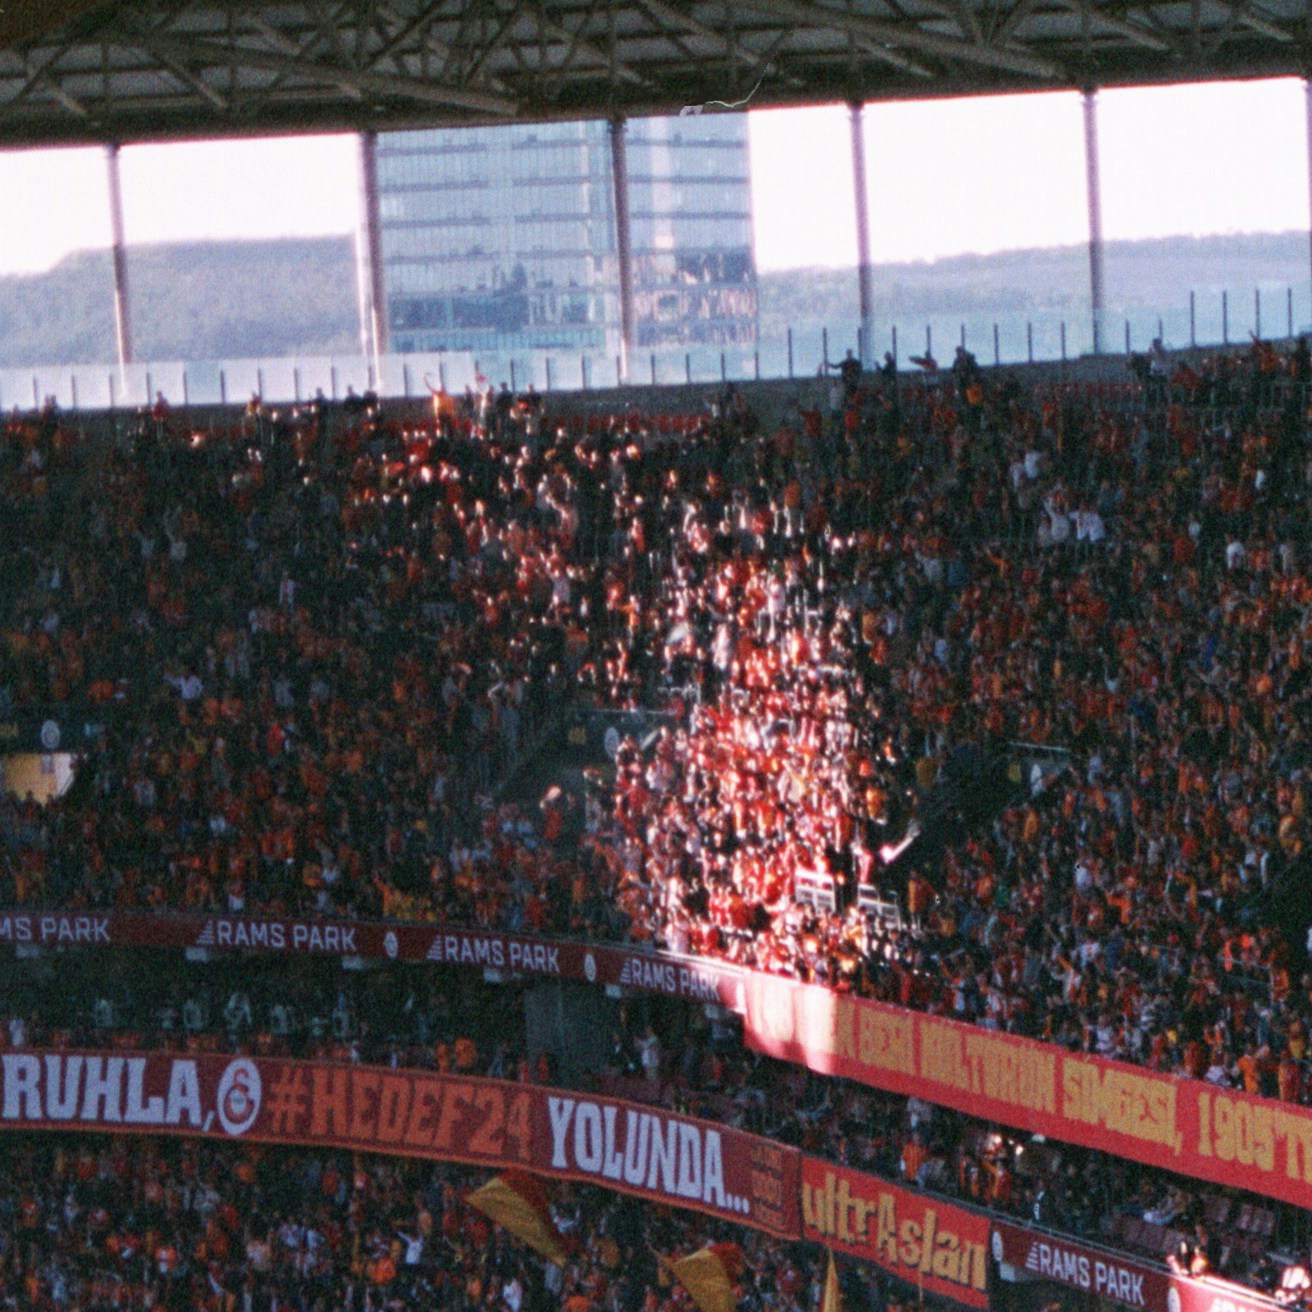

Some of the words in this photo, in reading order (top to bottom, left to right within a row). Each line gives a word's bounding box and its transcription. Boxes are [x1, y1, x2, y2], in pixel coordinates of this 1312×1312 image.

[40, 917, 112, 943] PARK
[216, 921, 286, 949] RAMS
[292, 924, 359, 952] PARK
[443, 934, 505, 967] RAMS
[509, 943, 562, 973] PARK
[631, 958, 677, 994] RAMS
[679, 968, 721, 1002] PARK
[1, 1054, 215, 1133] RUHLA,
[547, 1095, 751, 1215] YOLUNDA...
[802, 1172, 988, 1291] ultrAslan
[1038, 1243, 1091, 1289] RAMS
[1094, 1261, 1146, 1307] PARK
